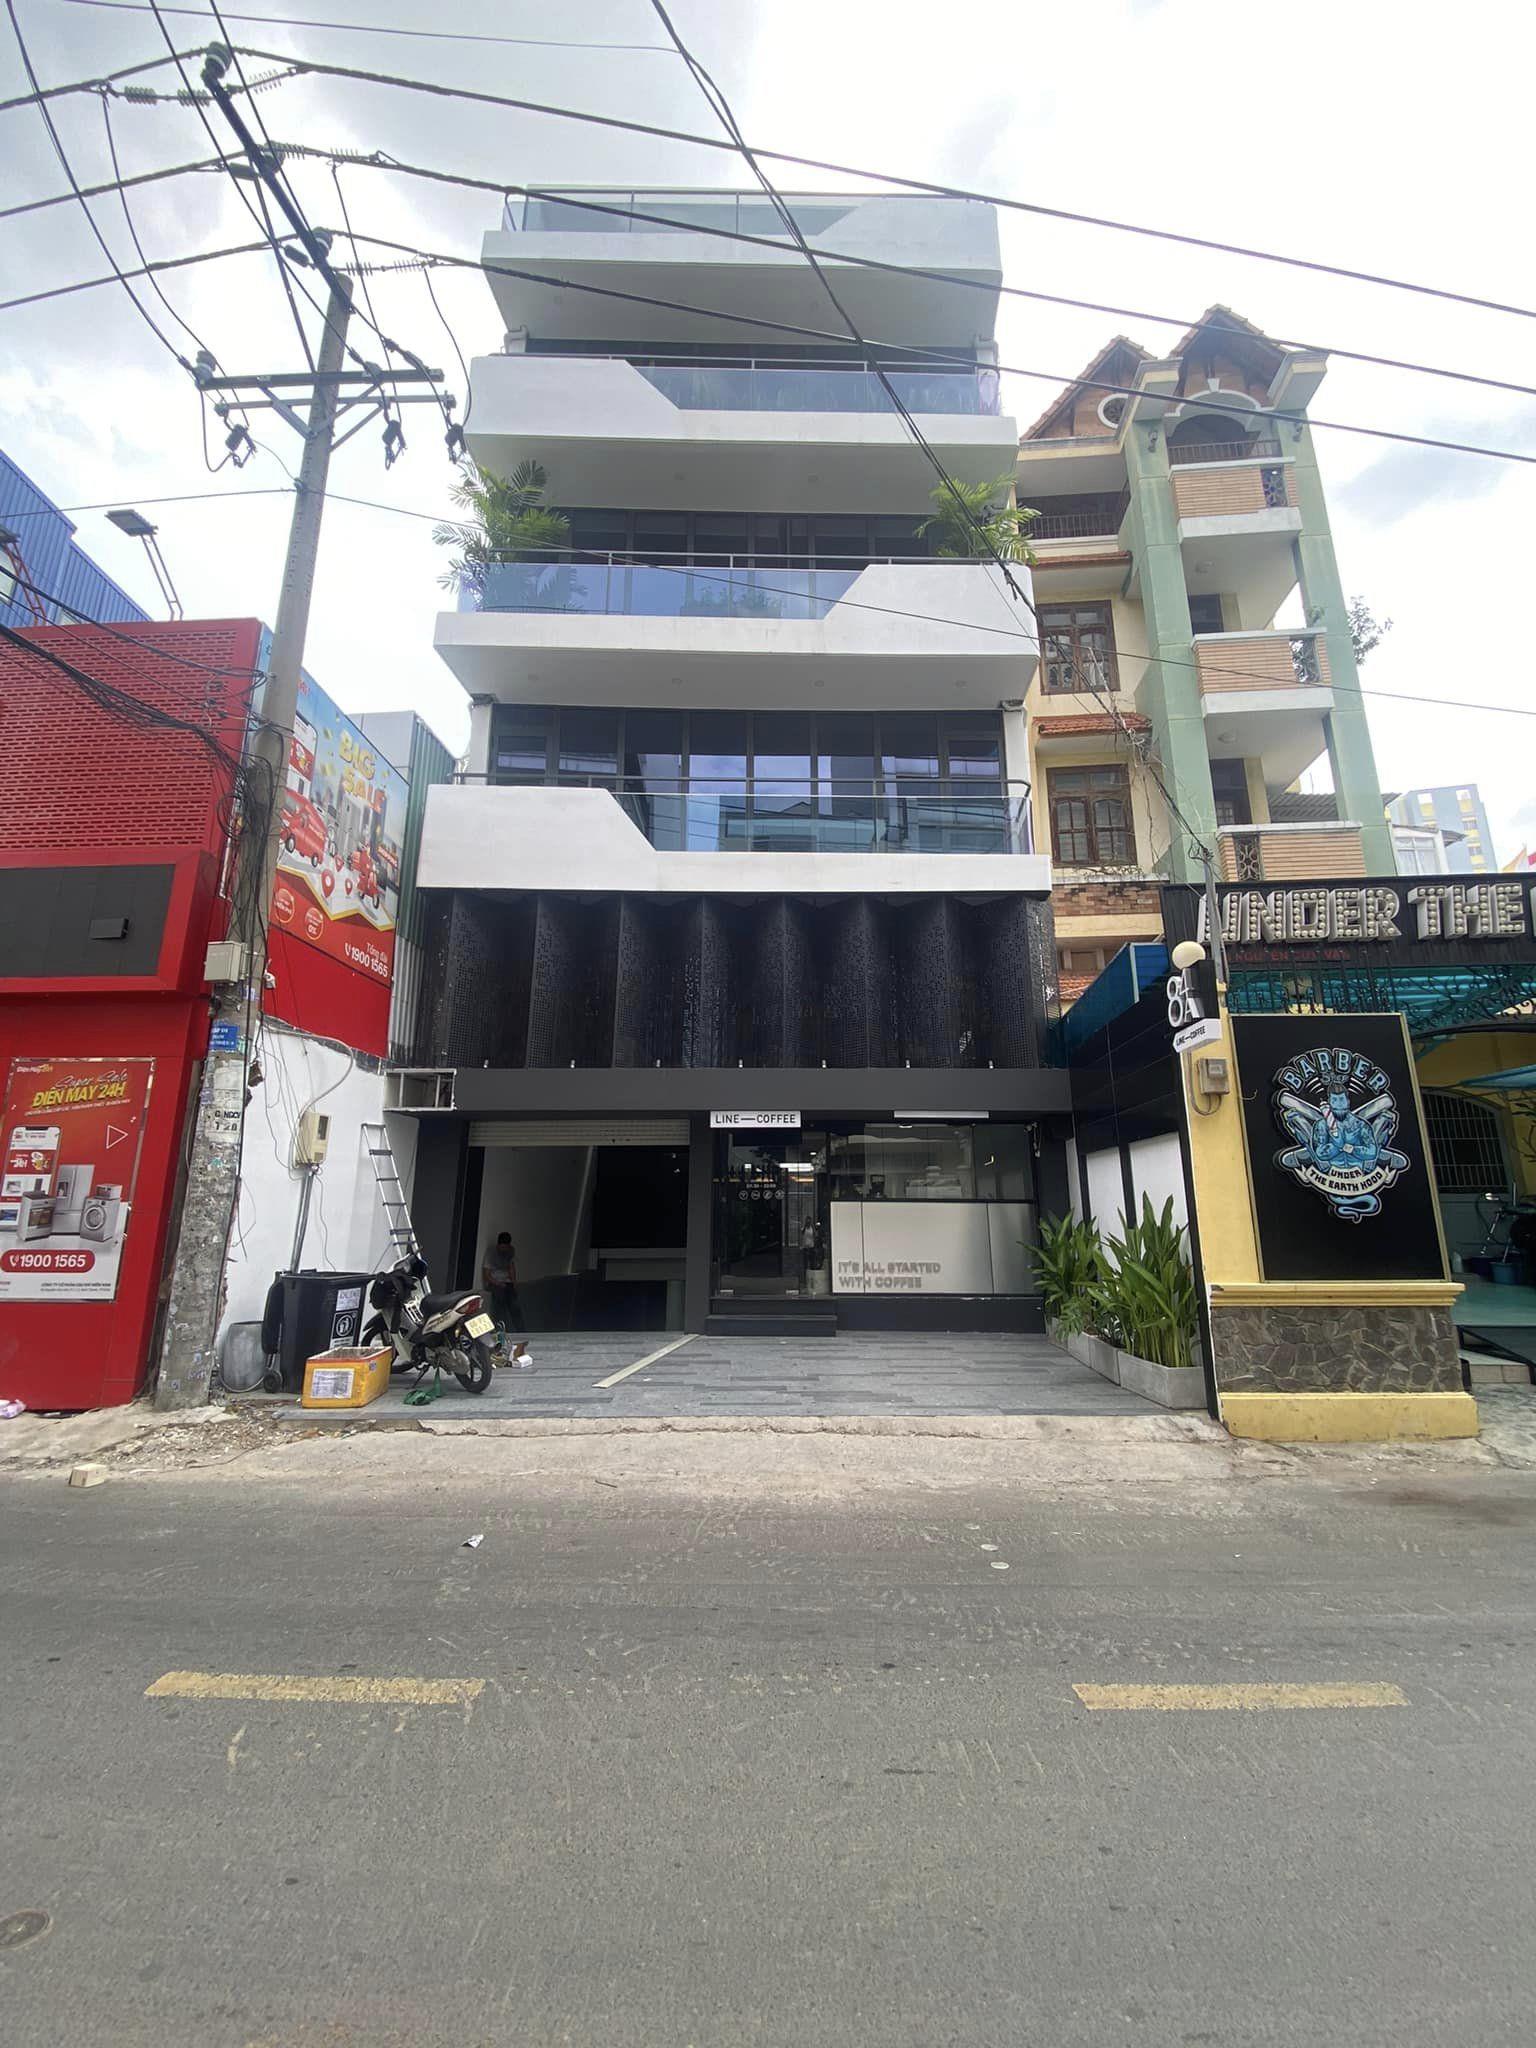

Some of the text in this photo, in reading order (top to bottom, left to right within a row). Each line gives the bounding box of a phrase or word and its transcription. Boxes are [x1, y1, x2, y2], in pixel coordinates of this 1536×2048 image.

[339, 730, 377, 779] BIG
[342, 766, 388, 815] SALE
[1198, 887, 1402, 944] UNDER
[1407, 883, 1526, 940] THE
[351, 946, 389, 977] 1900 1565
[1283, 1051, 1388, 1091] BARBER
[98, 1081, 127, 1099] 24H
[1308, 1170, 1327, 1187] THE
[1328, 1181, 1360, 1192] EARTH
[1330, 1169, 1362, 1178] UNDER
[19, 1254, 87, 1268] 1900 1565
[838, 1260, 942, 1274] IT'S ALL STARTED
[838, 1276, 923, 1289] WITH COFFEE
